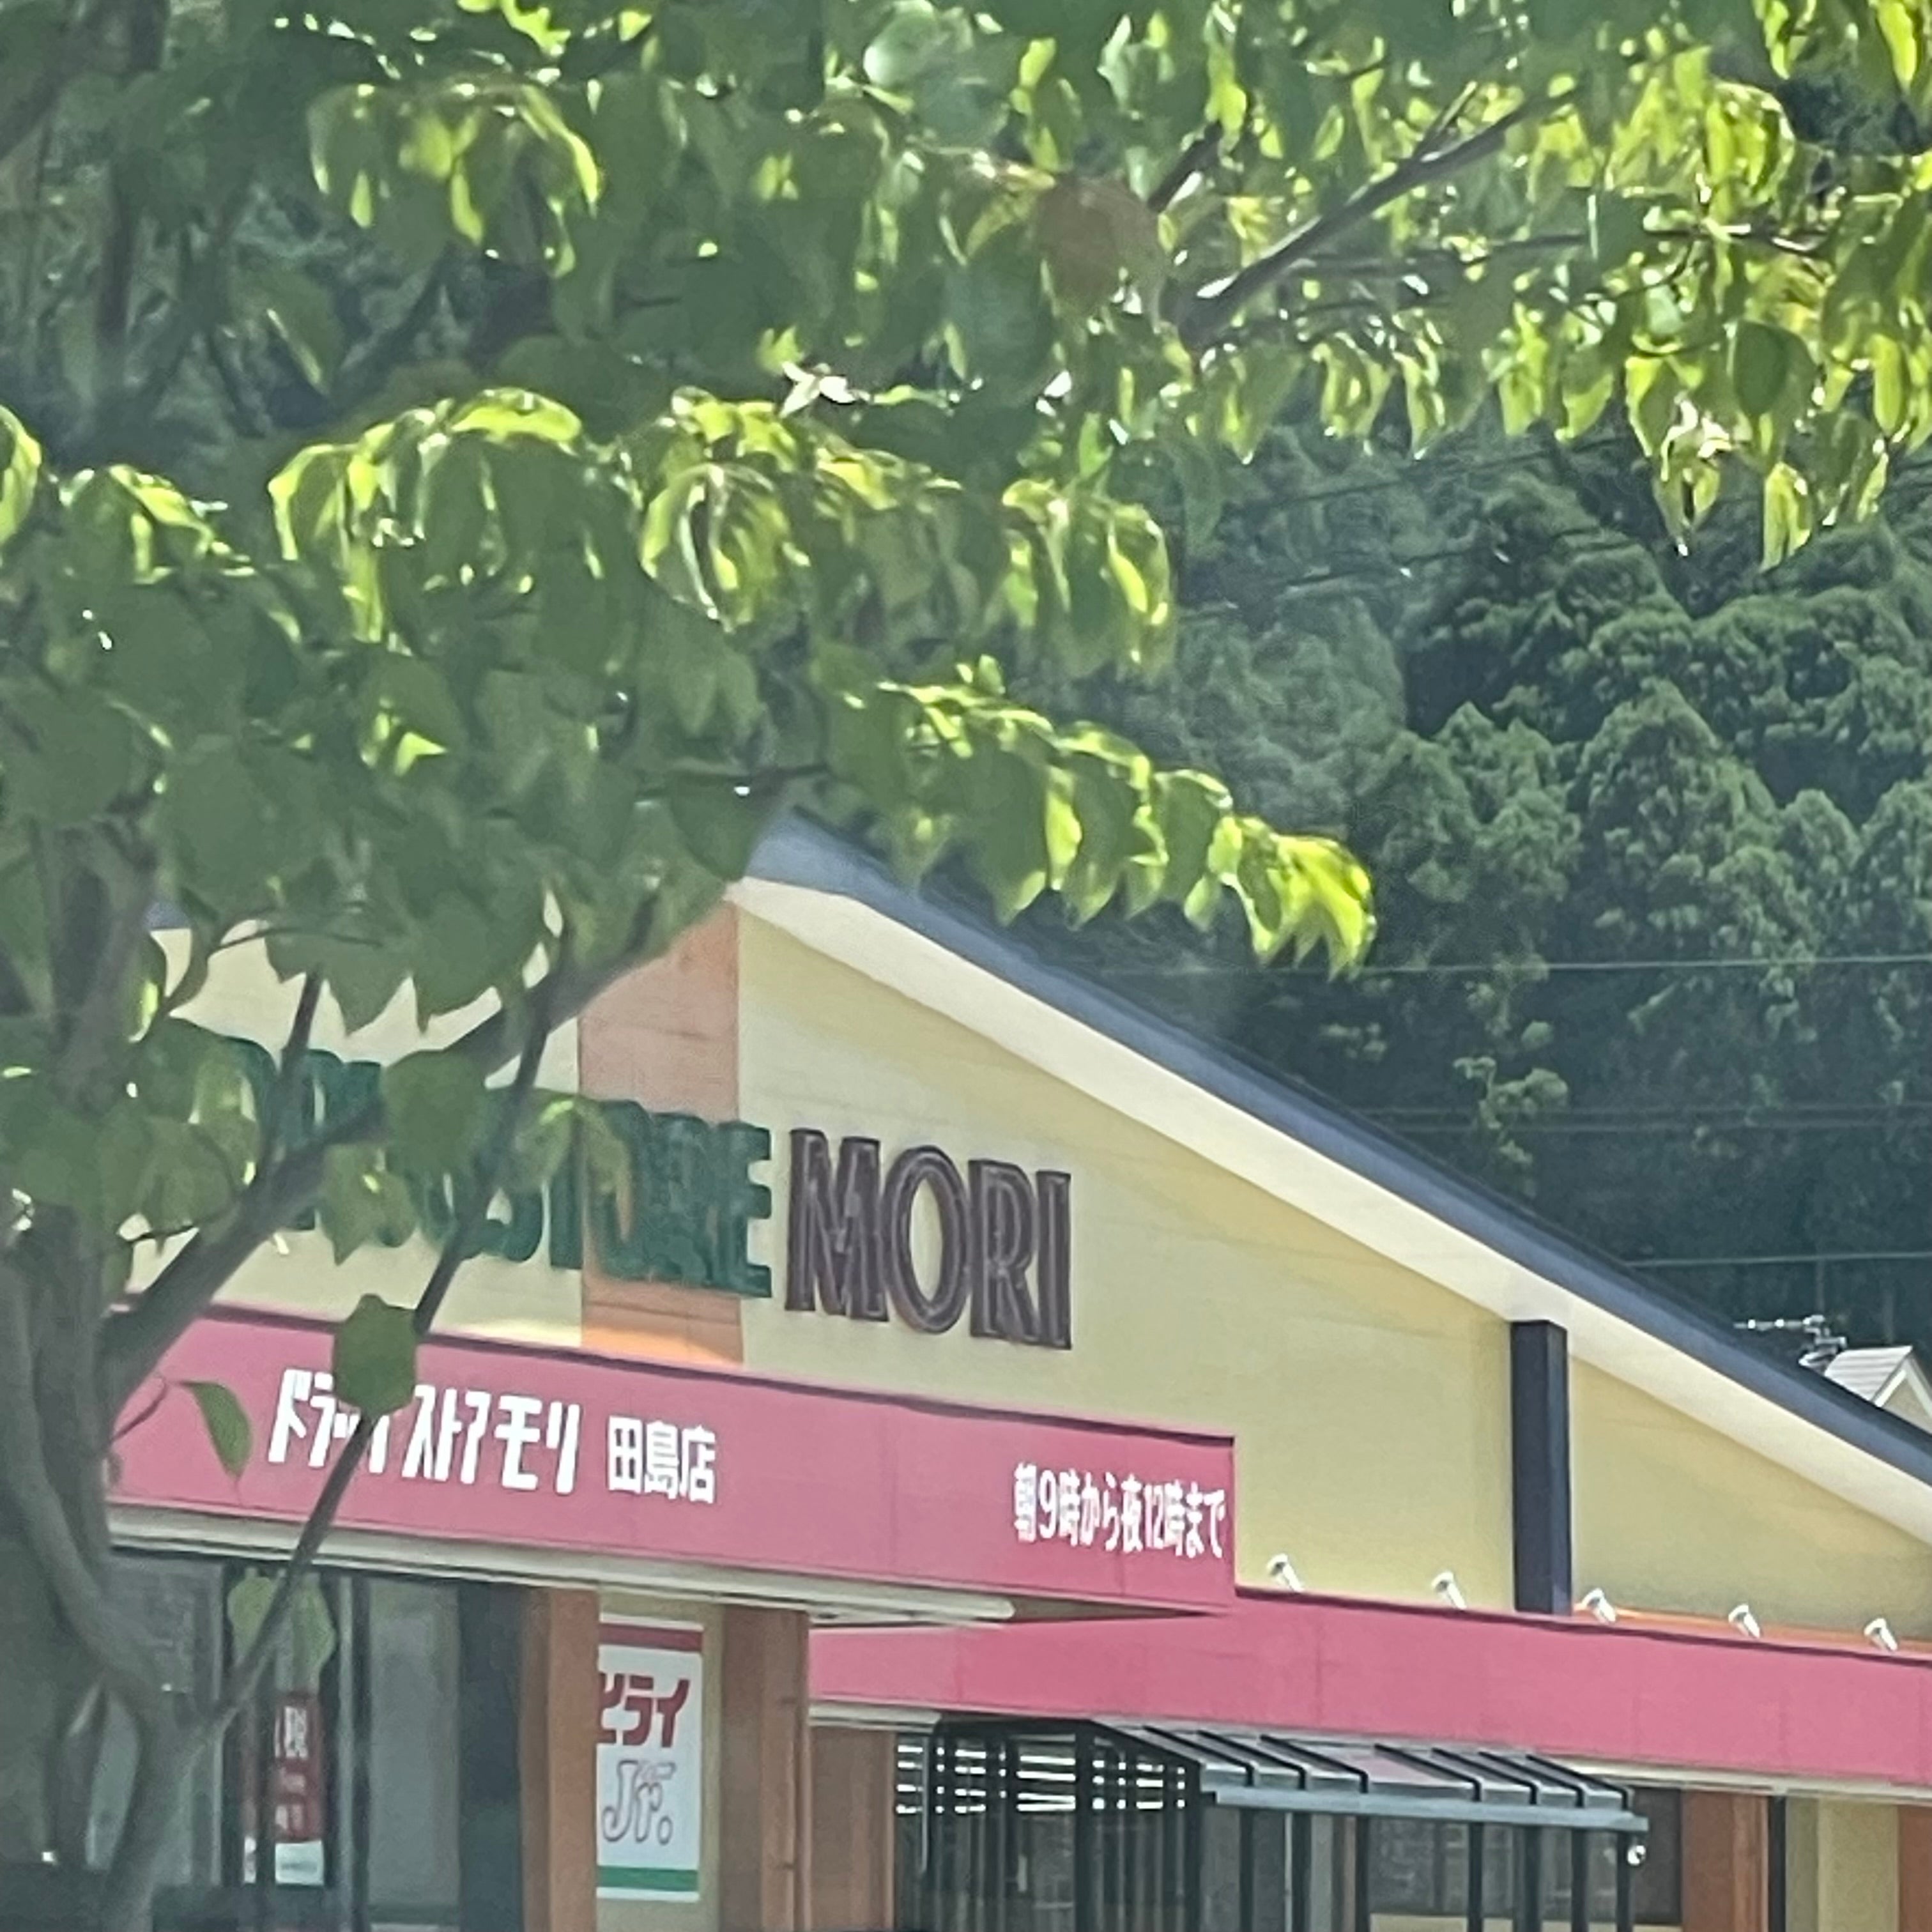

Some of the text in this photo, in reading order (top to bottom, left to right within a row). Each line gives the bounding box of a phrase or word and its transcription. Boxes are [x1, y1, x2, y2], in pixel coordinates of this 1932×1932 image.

[785, 1128, 1073, 1350] MORI
[607, 1414, 717, 1504] 田島店
[1014, 1462, 1225, 1558] 朝9時から夜12時まで
